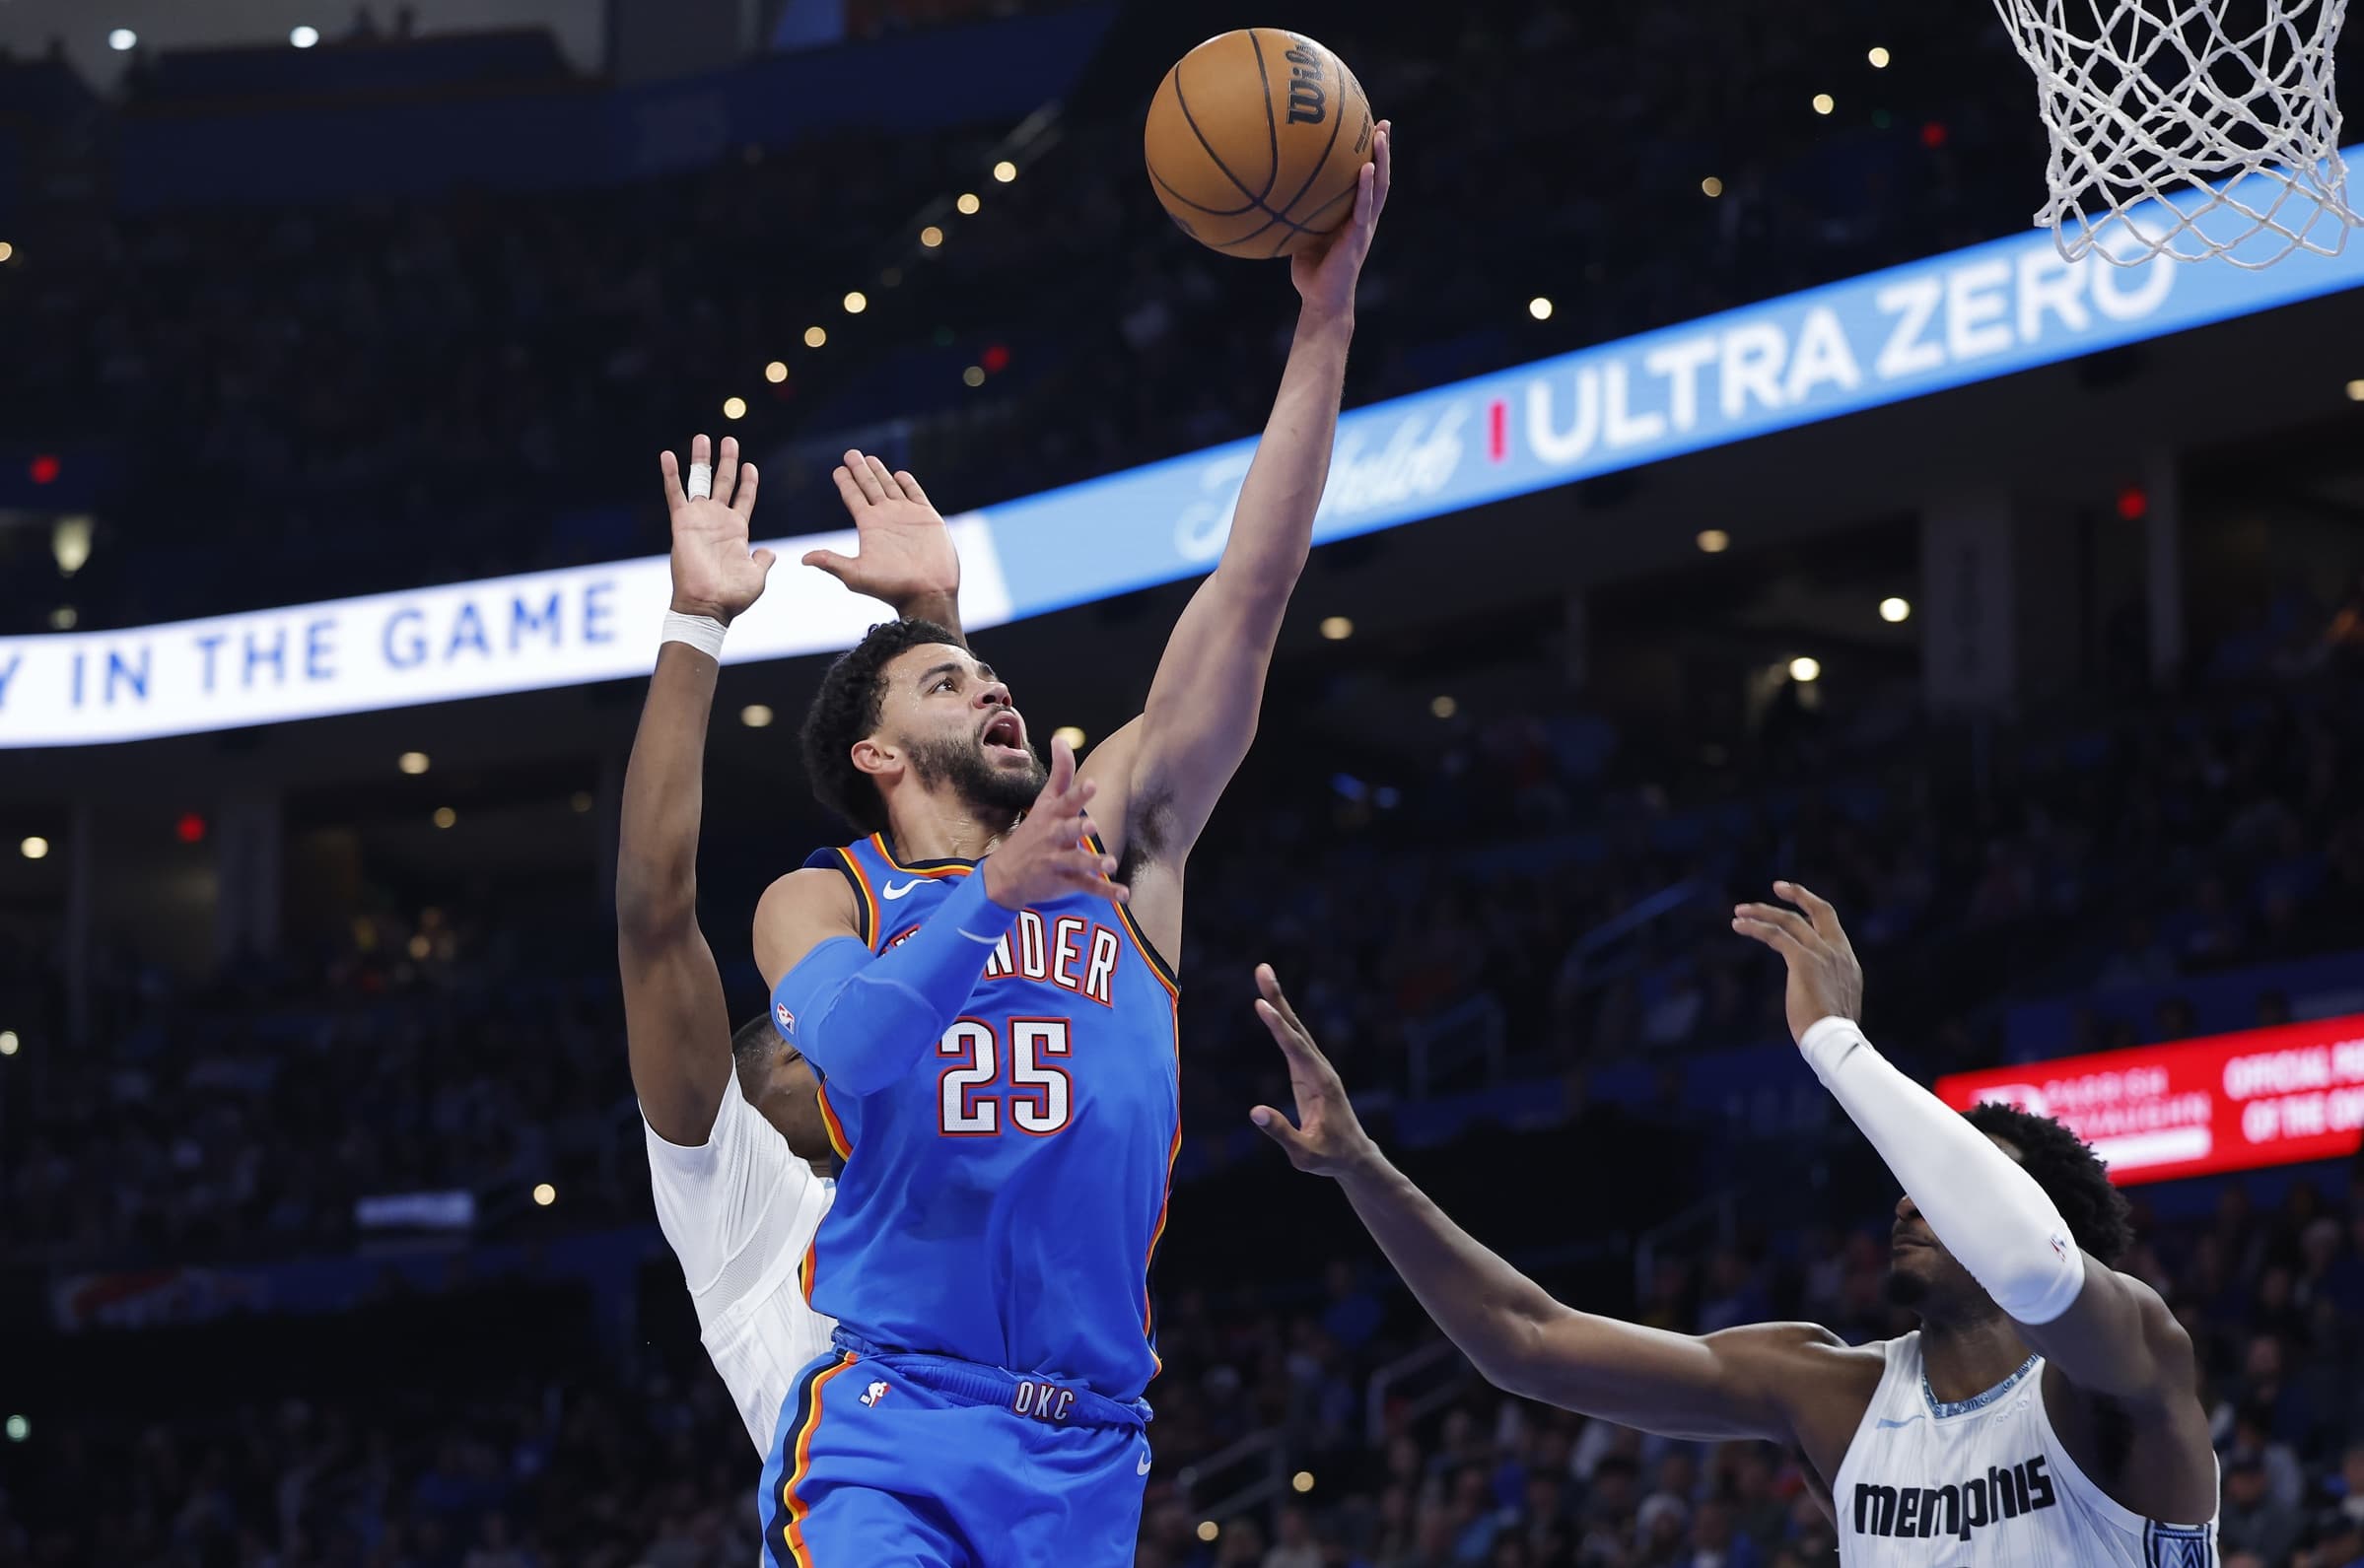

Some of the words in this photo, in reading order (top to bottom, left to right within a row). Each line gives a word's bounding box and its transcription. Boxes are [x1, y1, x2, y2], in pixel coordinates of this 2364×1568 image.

[1528, 306, 1860, 464] ULTRA
[1876, 222, 2175, 378] ZERO
[71, 646, 151, 710] IN
[194, 618, 338, 692] THE
[382, 579, 616, 671] GAME
[936, 1016, 1073, 1136] 25
[1014, 1380, 1075, 1420] OKC
